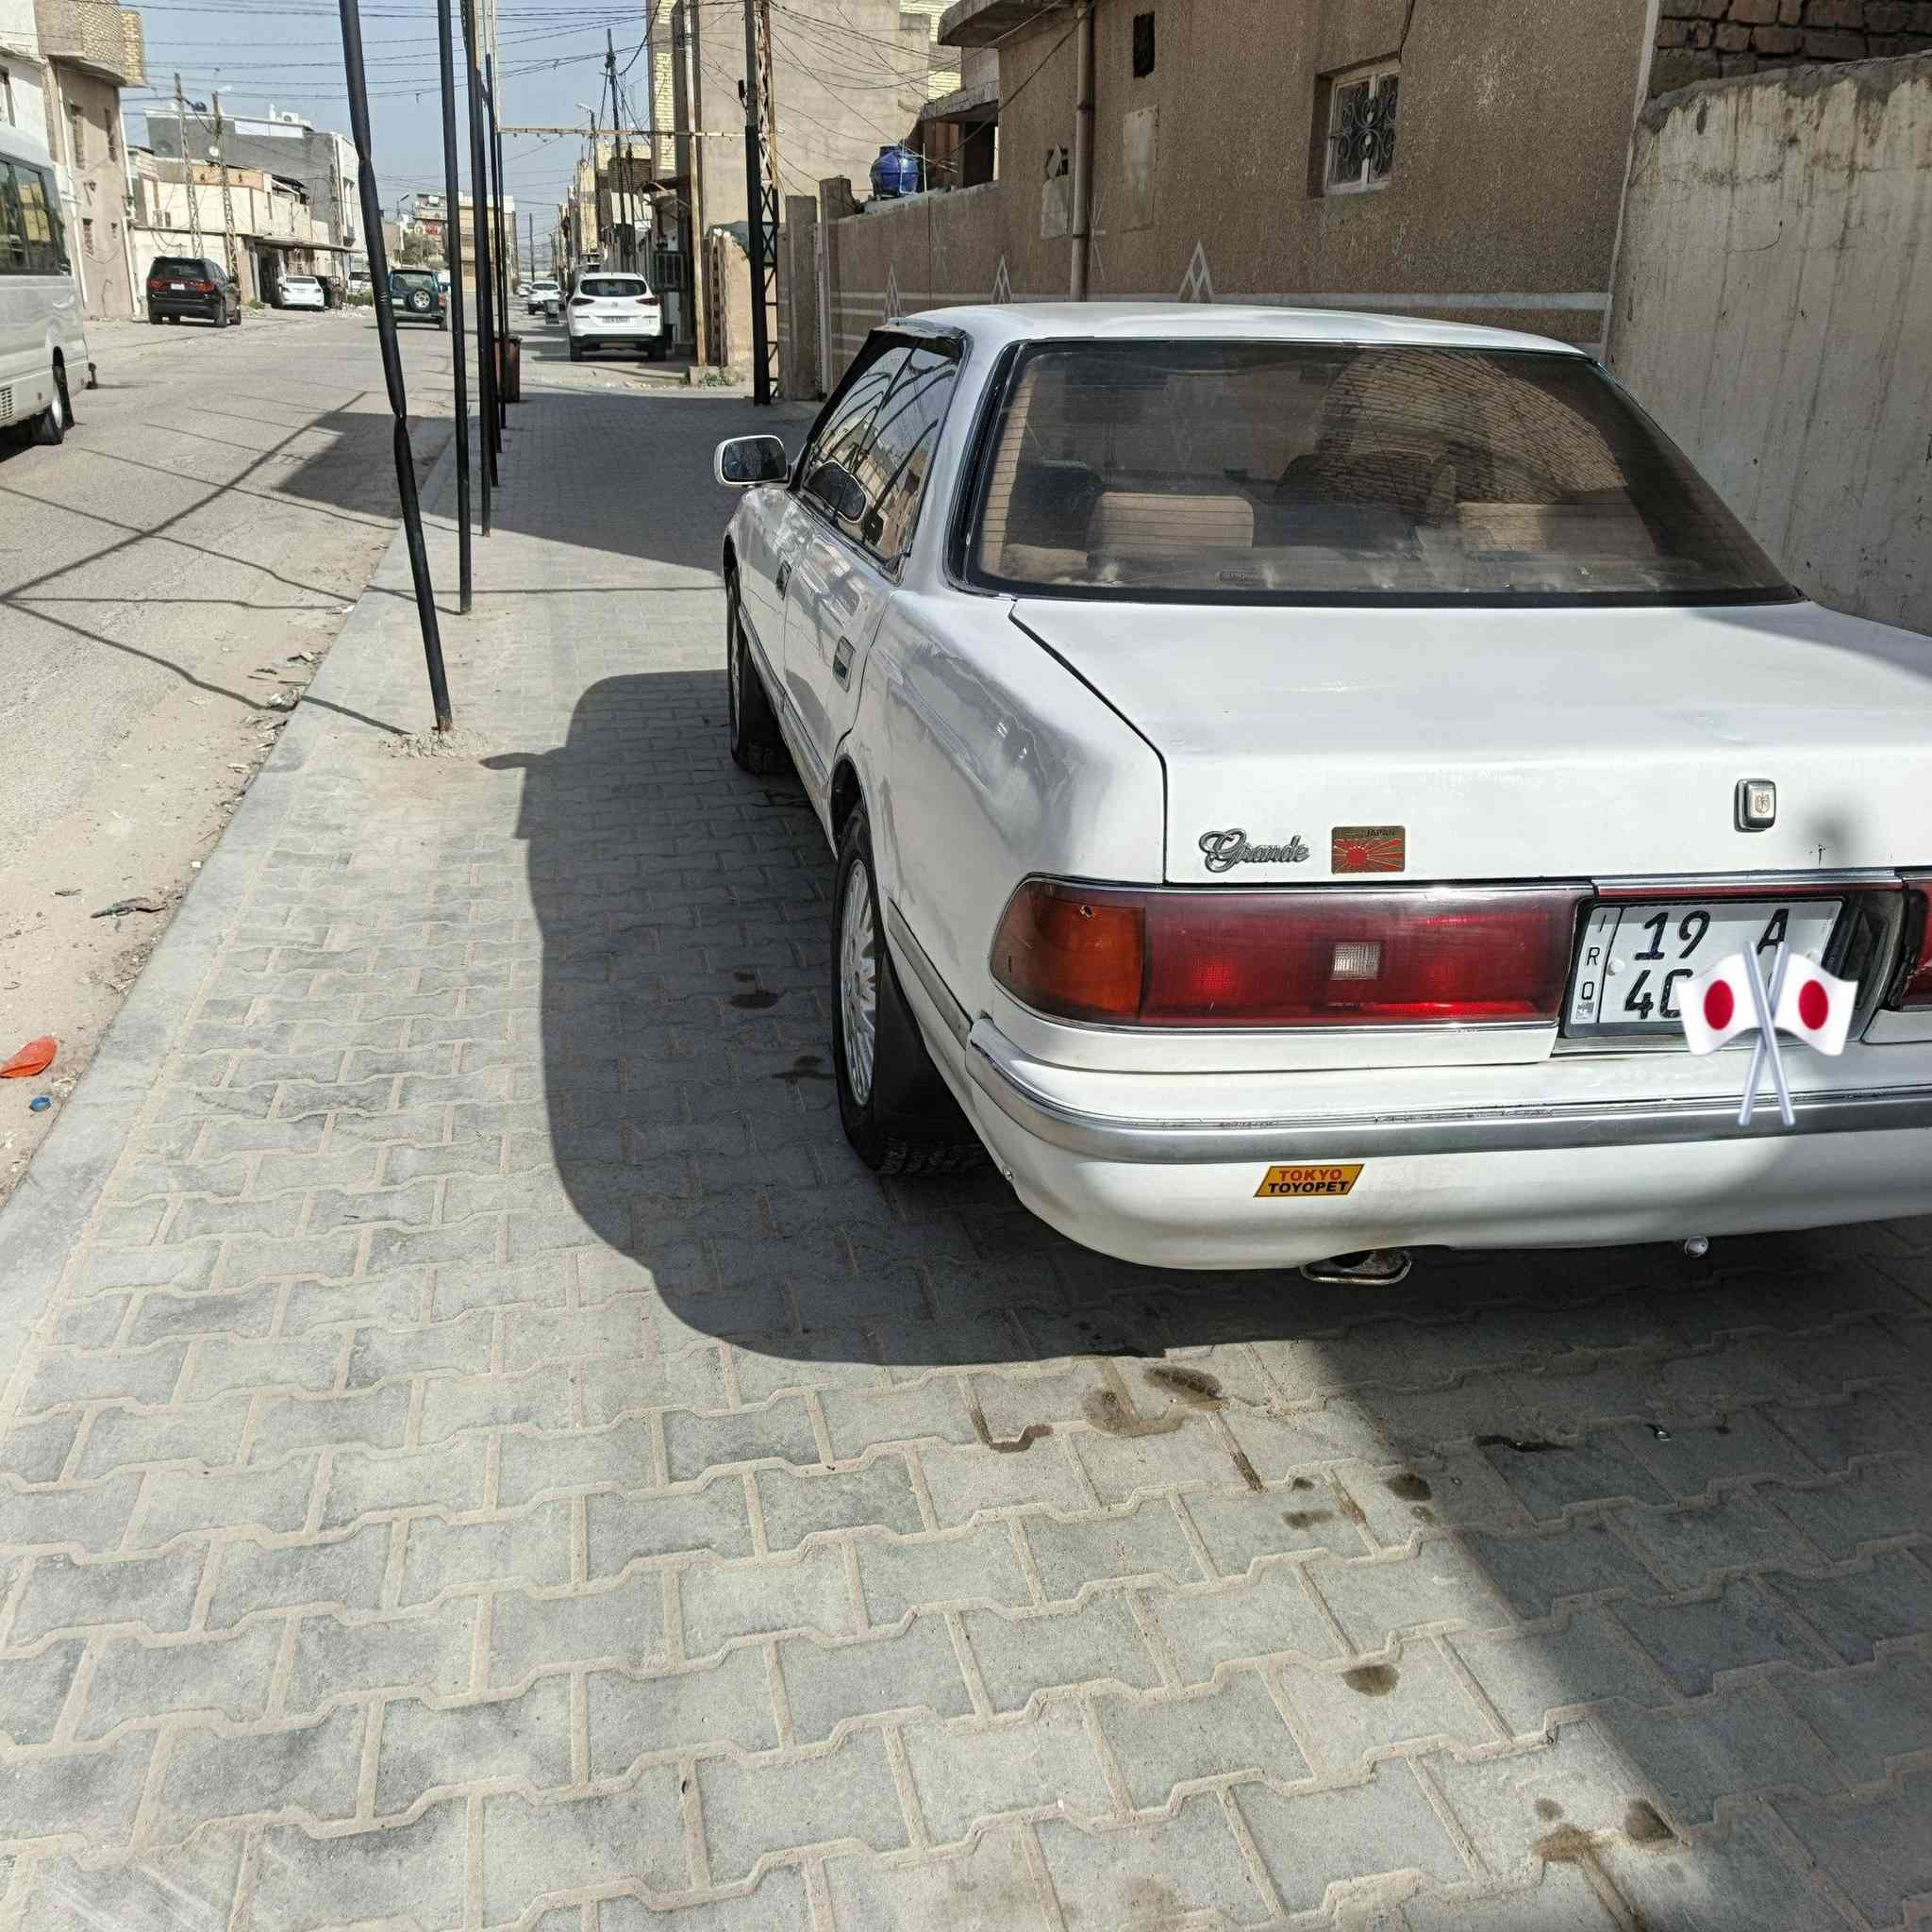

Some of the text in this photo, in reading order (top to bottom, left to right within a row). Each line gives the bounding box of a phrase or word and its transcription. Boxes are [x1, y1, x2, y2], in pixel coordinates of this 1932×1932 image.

[1199, 828, 1310, 874] Grande
[1634, 908, 1790, 960] 19 A
[1268, 1181, 1349, 1193] TOYOPET
[1279, 1169, 1342, 1181] TOKYO
